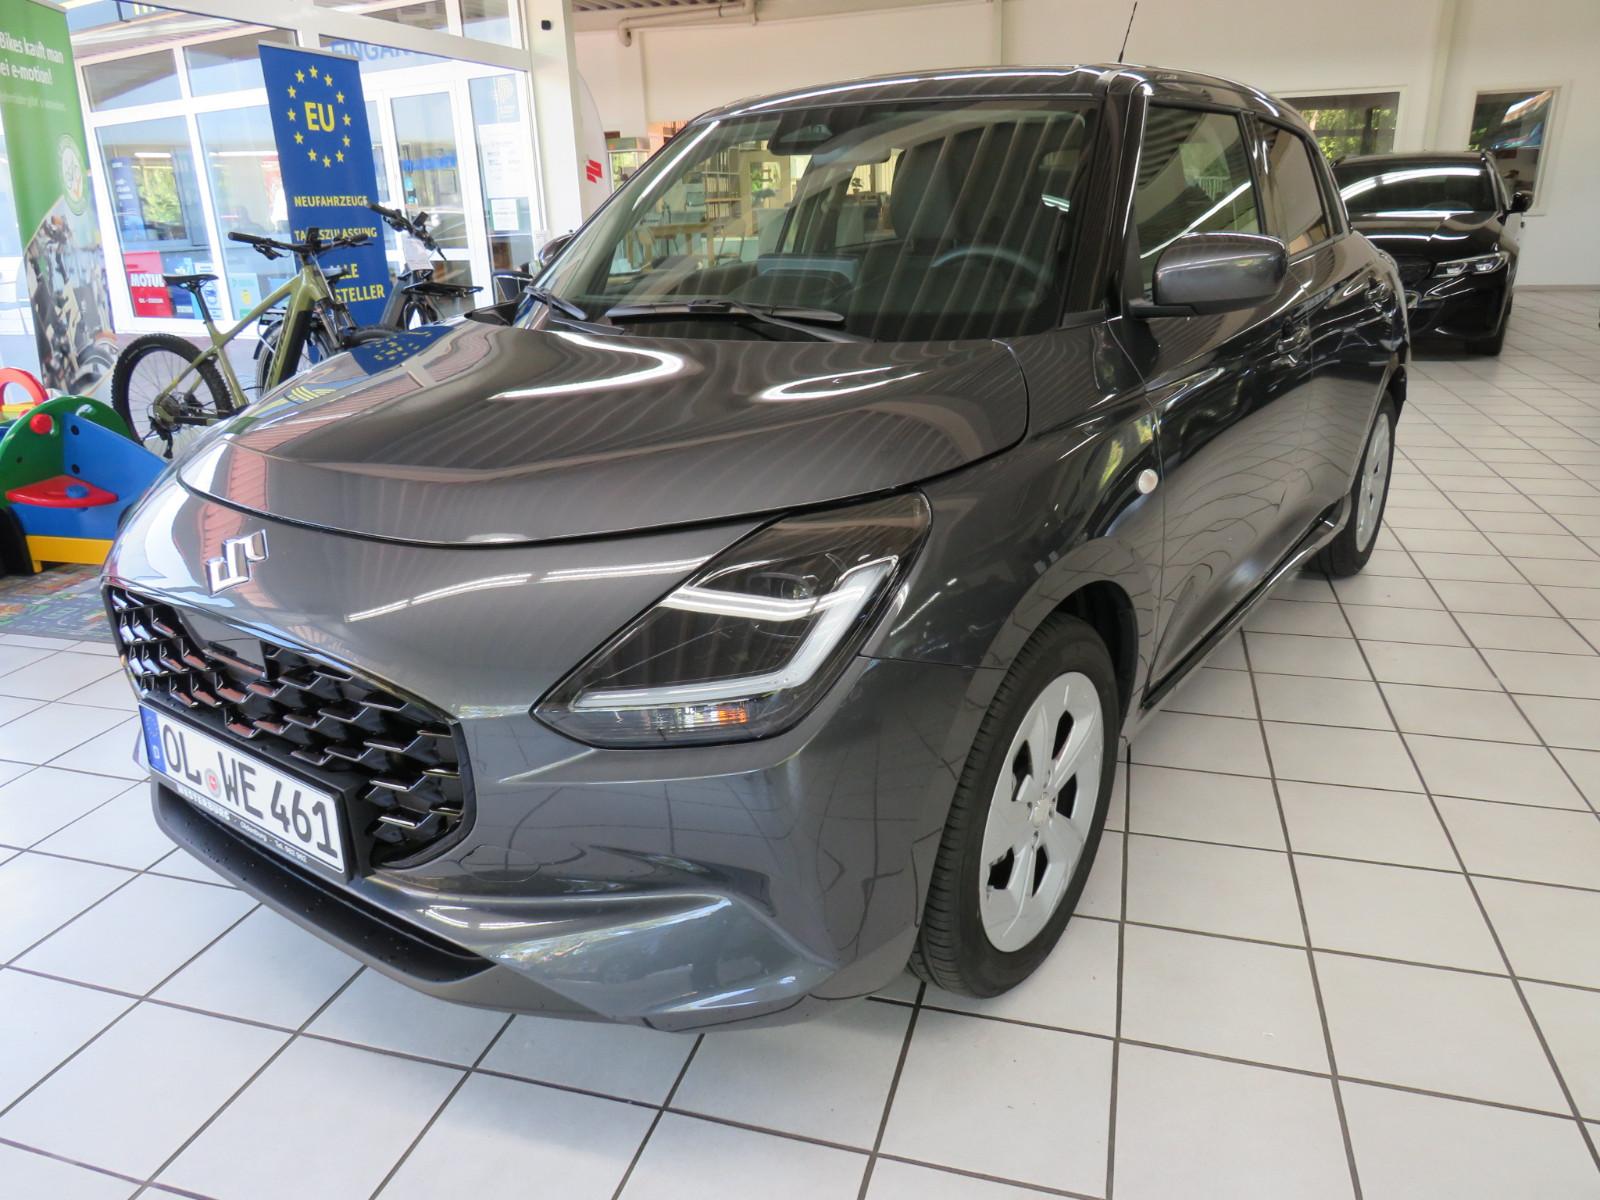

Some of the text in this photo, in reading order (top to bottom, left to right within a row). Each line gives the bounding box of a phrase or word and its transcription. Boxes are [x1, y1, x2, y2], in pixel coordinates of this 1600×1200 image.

[331, 40, 408, 61] EINGA
[0, 57, 10, 77] ei
[304, 101, 336, 133] EU
[130, 273, 166, 288] MOTUL
[335, 283, 386, 304] STELLER
[162, 724, 202, 786] OL
[217, 751, 264, 820] WE
[270, 779, 338, 859] 461
